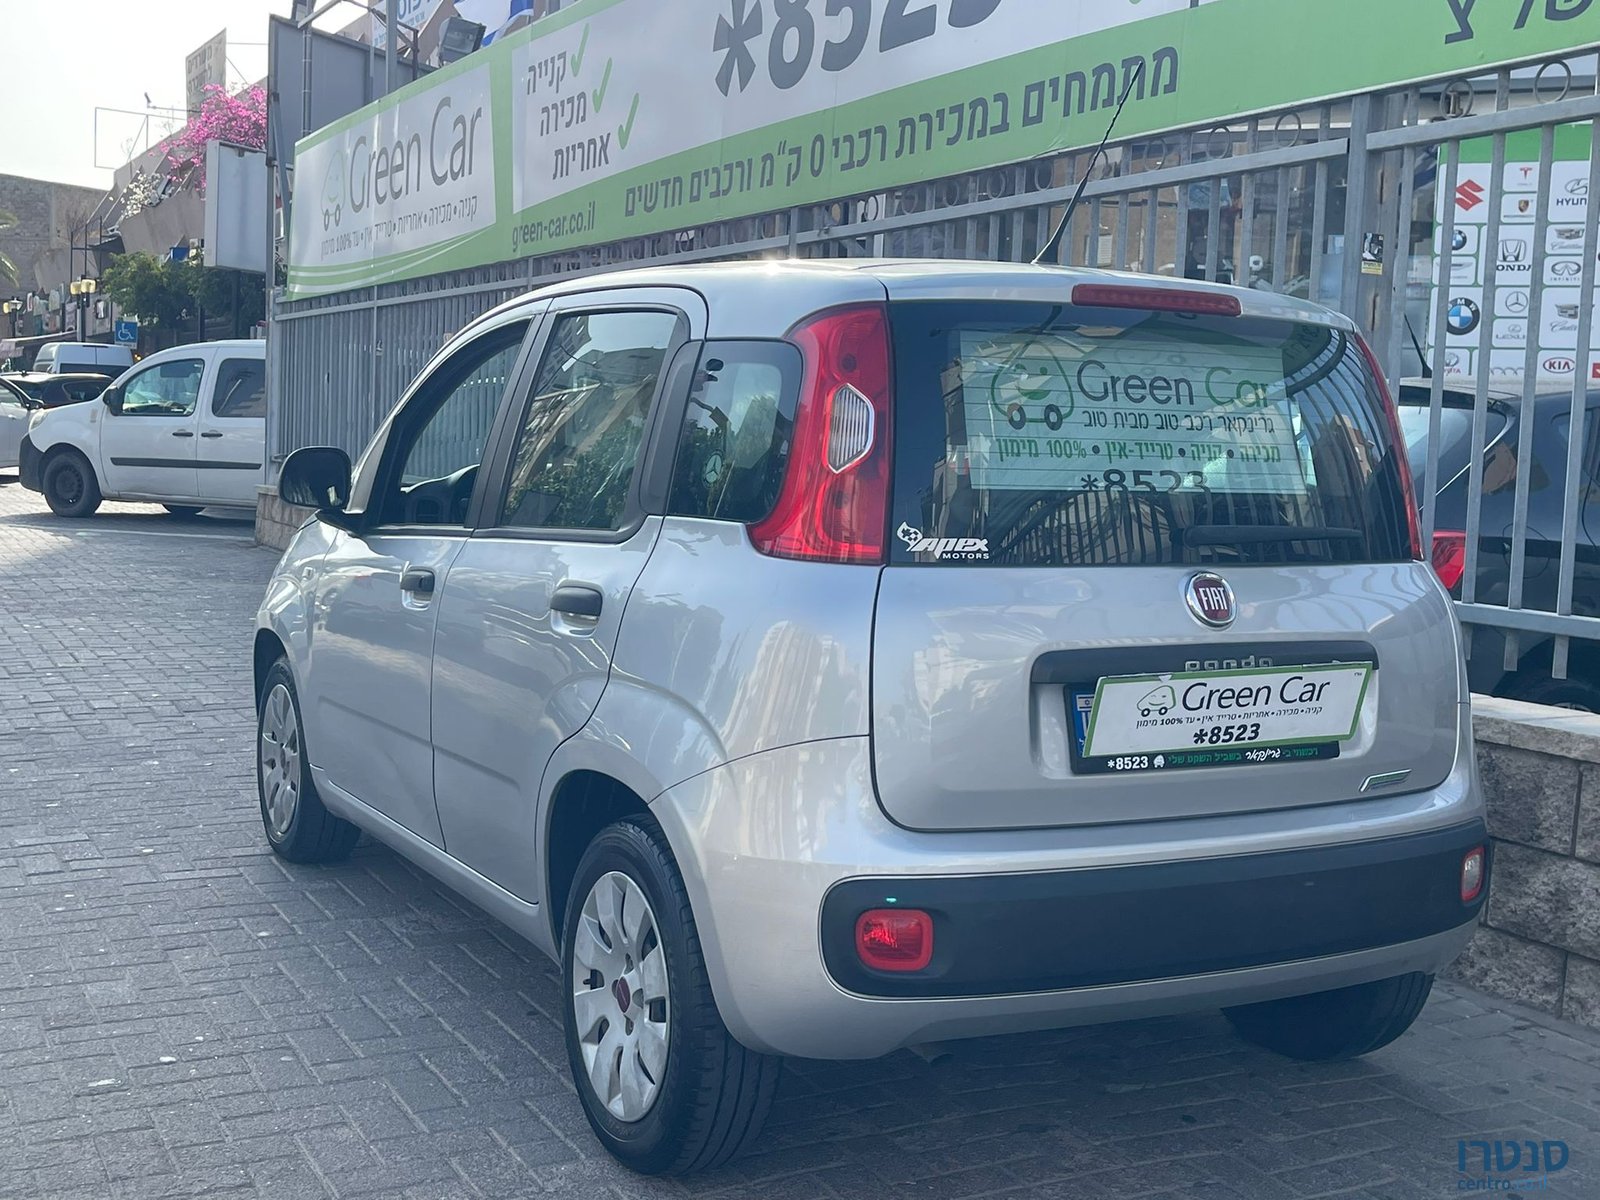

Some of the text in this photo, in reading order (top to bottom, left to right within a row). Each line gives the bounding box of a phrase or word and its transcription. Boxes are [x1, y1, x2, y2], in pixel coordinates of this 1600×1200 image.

[527, 51, 567, 95] קנייה
[1022, 46, 1179, 128] מתמחים
[540, 91, 587, 136] מכירה
[895, 92, 1010, 158] במכירת
[350, 96, 482, 213] Green Car
[552, 133, 611, 180] אחריות
[810, 133, 825, 178] 0
[832, 125, 888, 172] רכבי
[689, 158, 753, 203] ורכבים
[458, 196, 477, 222] קניה
[625, 176, 683, 217] חדשים
[1556, 197, 1587, 206] HYUN
[397, 211, 423, 236] אחריות
[429, 203, 451, 227] מכירה
[512, 201, 595, 253] green-car.co.il
[1549, 361, 1571, 370] KIA
[1077, 359, 1269, 408] Green Car
[1082, 410, 1276, 437] גרינקאר רכב טוב מבית טוב
[996, 438, 1040, 462] מימון
[1046, 439, 1087, 459] 100%
[1239, 445, 1281, 463] מכירה
[942, 552, 990, 560] MOTORS
[1198, 587, 1228, 611] FIAT
[1182, 676, 1331, 712] Green Car
[1160, 717, 1183, 726] 100%
[1185, 716, 1195, 725] עד
[1201, 714, 1214, 724] אין
[1242, 710, 1270, 720] אחריות
[1275, 708, 1300, 717] מכירה
[1304, 706, 1323, 715] קניה
[1136, 718, 1158, 729] מימון
